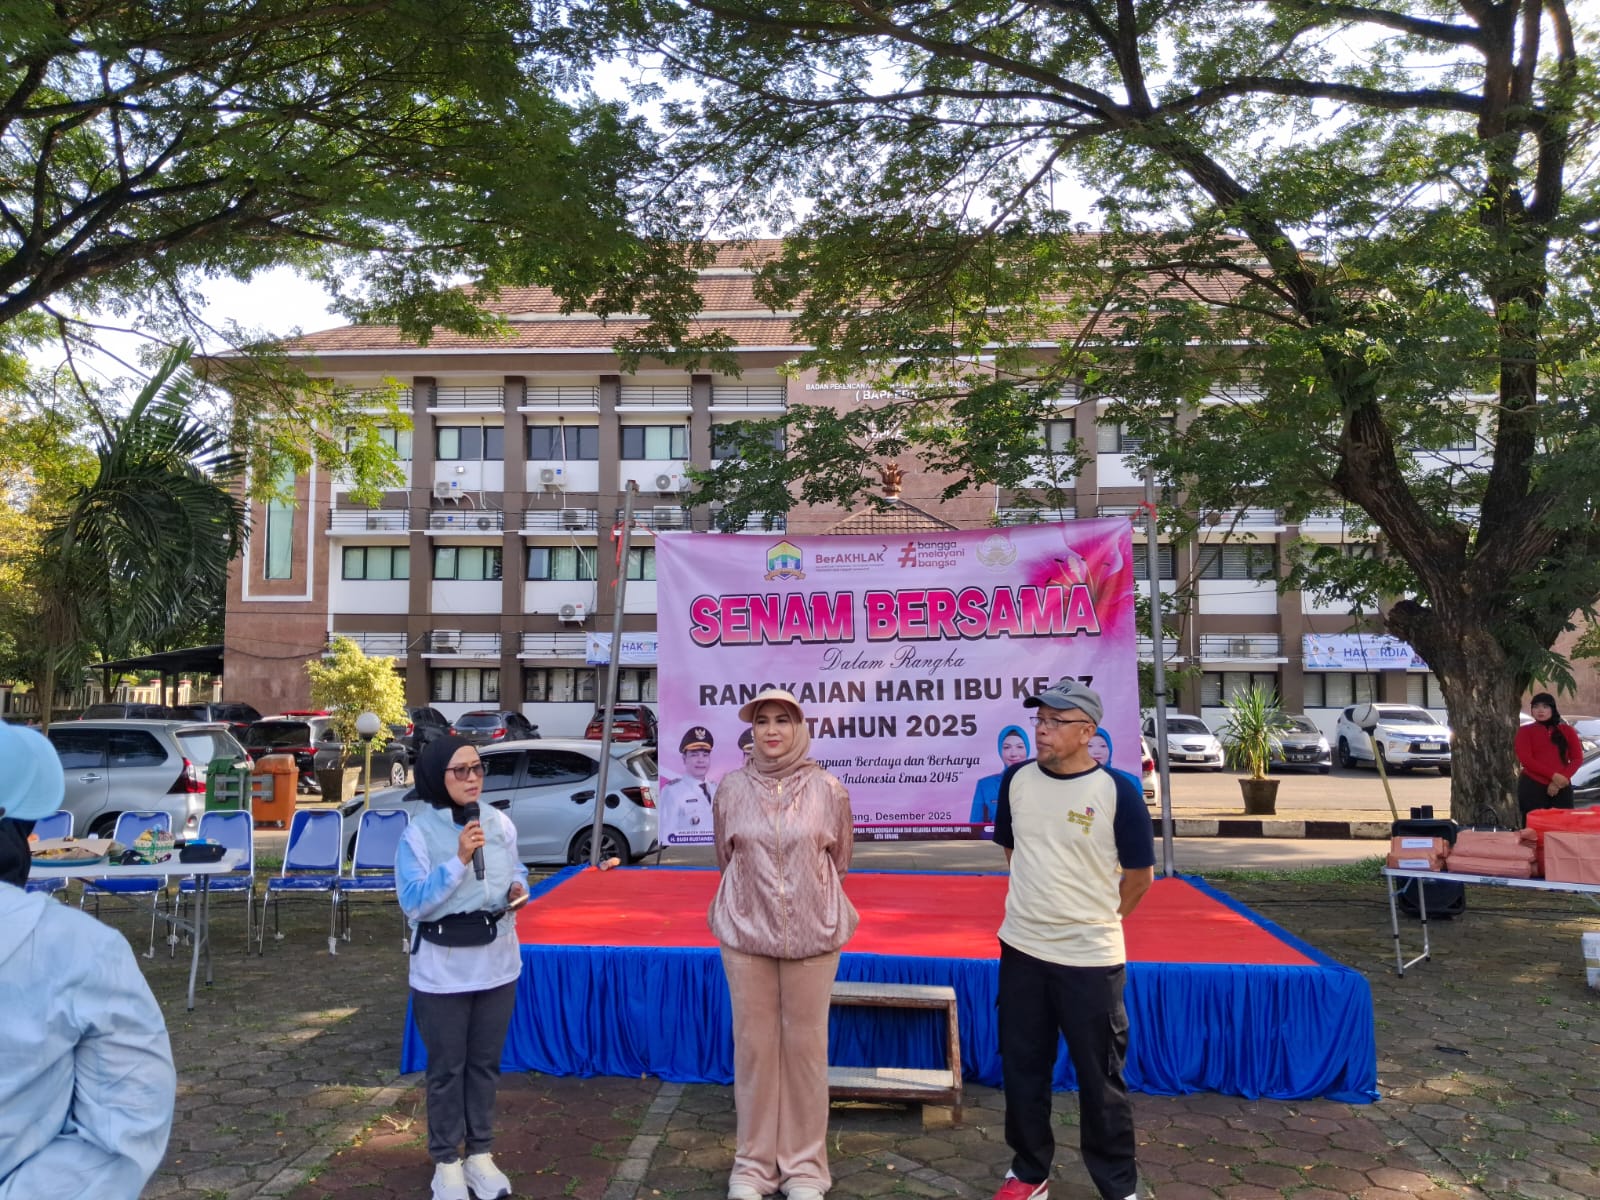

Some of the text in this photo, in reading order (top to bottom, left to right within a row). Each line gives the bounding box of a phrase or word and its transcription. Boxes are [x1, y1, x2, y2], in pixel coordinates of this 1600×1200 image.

[918, 541, 957, 551] bangga
[815, 552, 885, 564] BerAKHLAK
[918, 548, 965, 559] melayani
[918, 559, 957, 569] bangsa
[690, 583, 1101, 648] SENAM BERSAMA
[819, 645, 965, 676] Dalam Rangka
[875, 678, 945, 702] HARI
[954, 677, 1002, 700] IBU
[1012, 676, 1050, 700] KE
[805, 714, 978, 739] TAHUN 2025
[816, 754, 980, 770] mpuan Berdaya dan Berkarya
[842, 772, 896, 784] Indonesia
[899, 771, 927, 784] Emas
[852, 811, 952, 823] ang, Desember 2025
